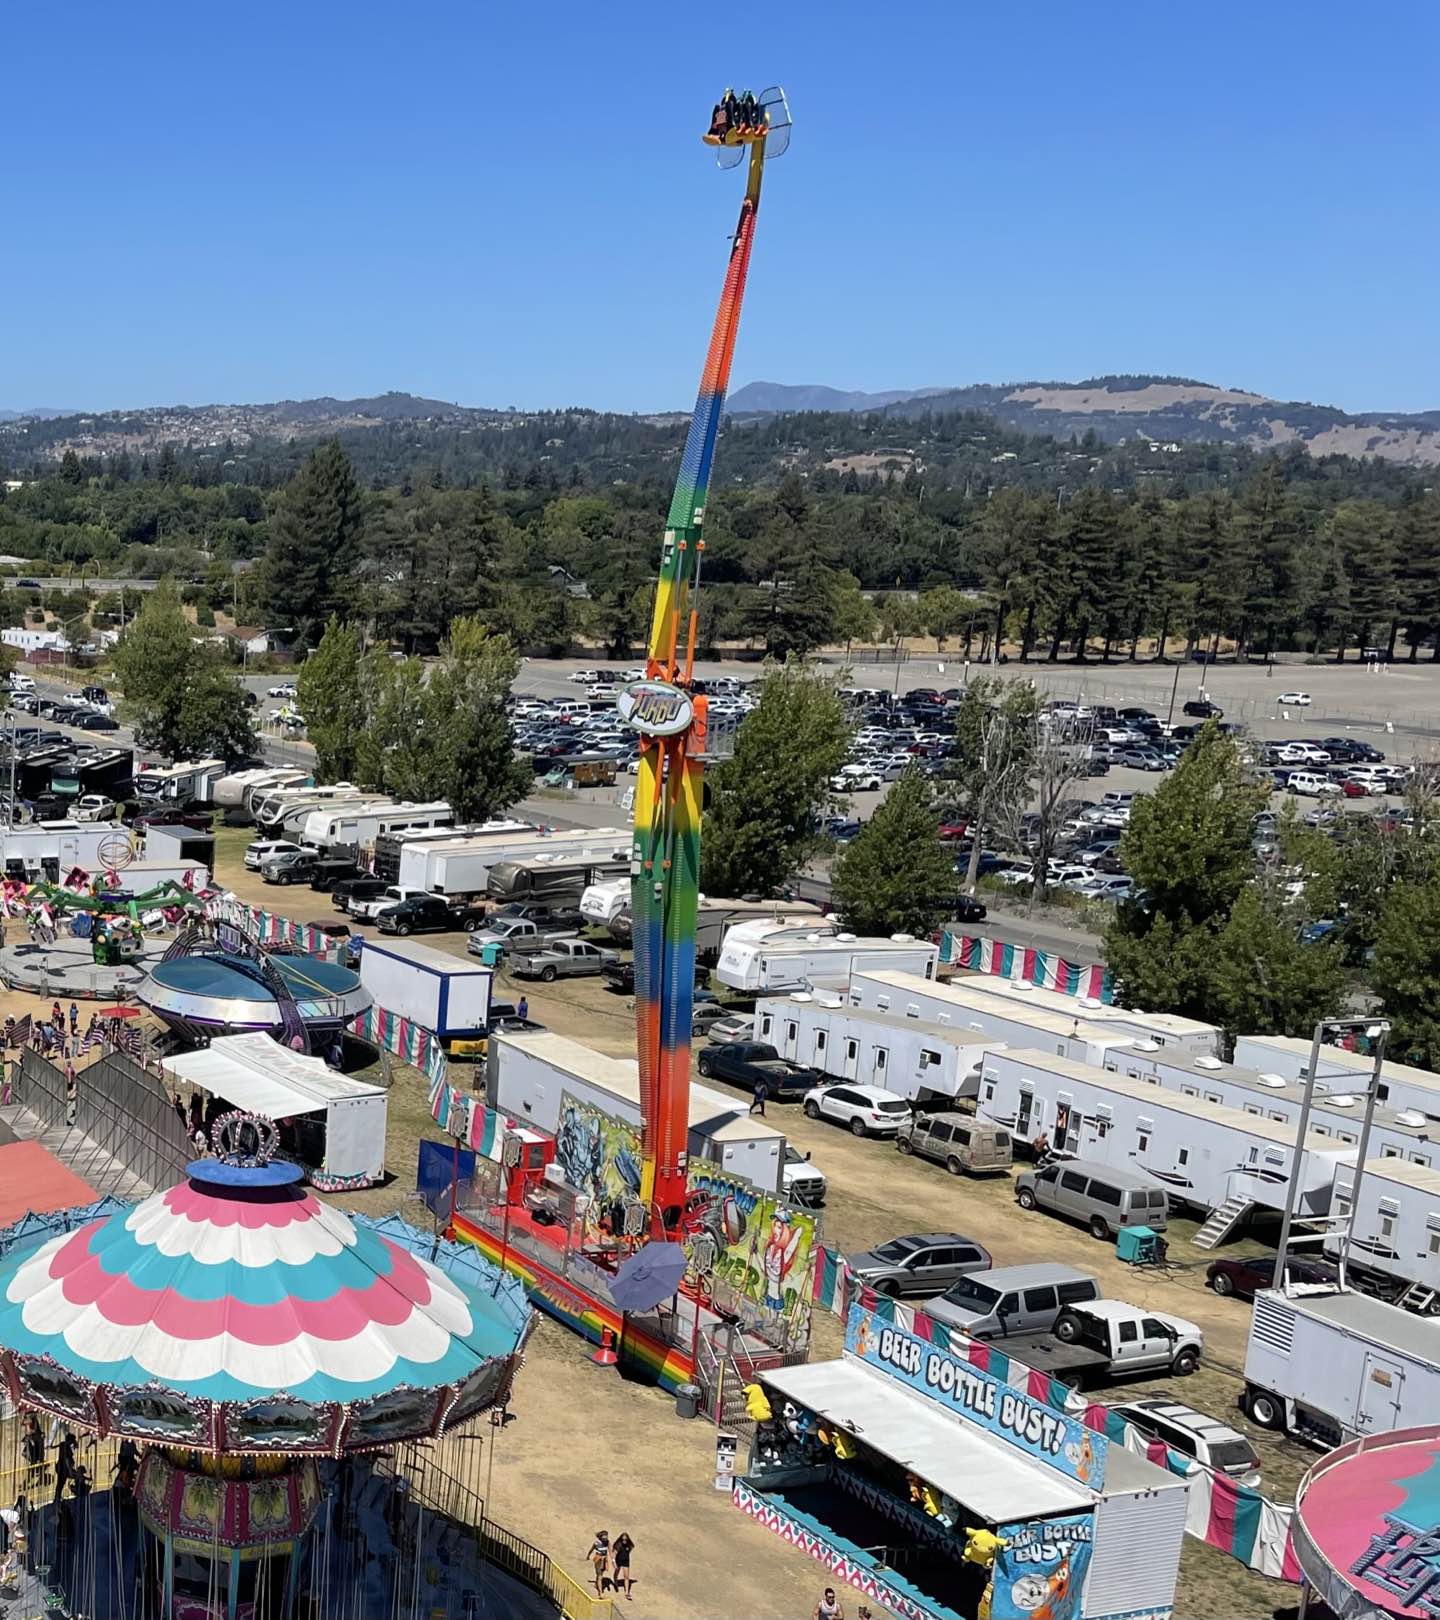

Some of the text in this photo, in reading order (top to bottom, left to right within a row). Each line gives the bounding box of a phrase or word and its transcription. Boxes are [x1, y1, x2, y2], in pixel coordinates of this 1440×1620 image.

[879, 1328, 1067, 1456] BEER BOTTLE BUST!
[1043, 1524, 1092, 1542] BOTTLE
